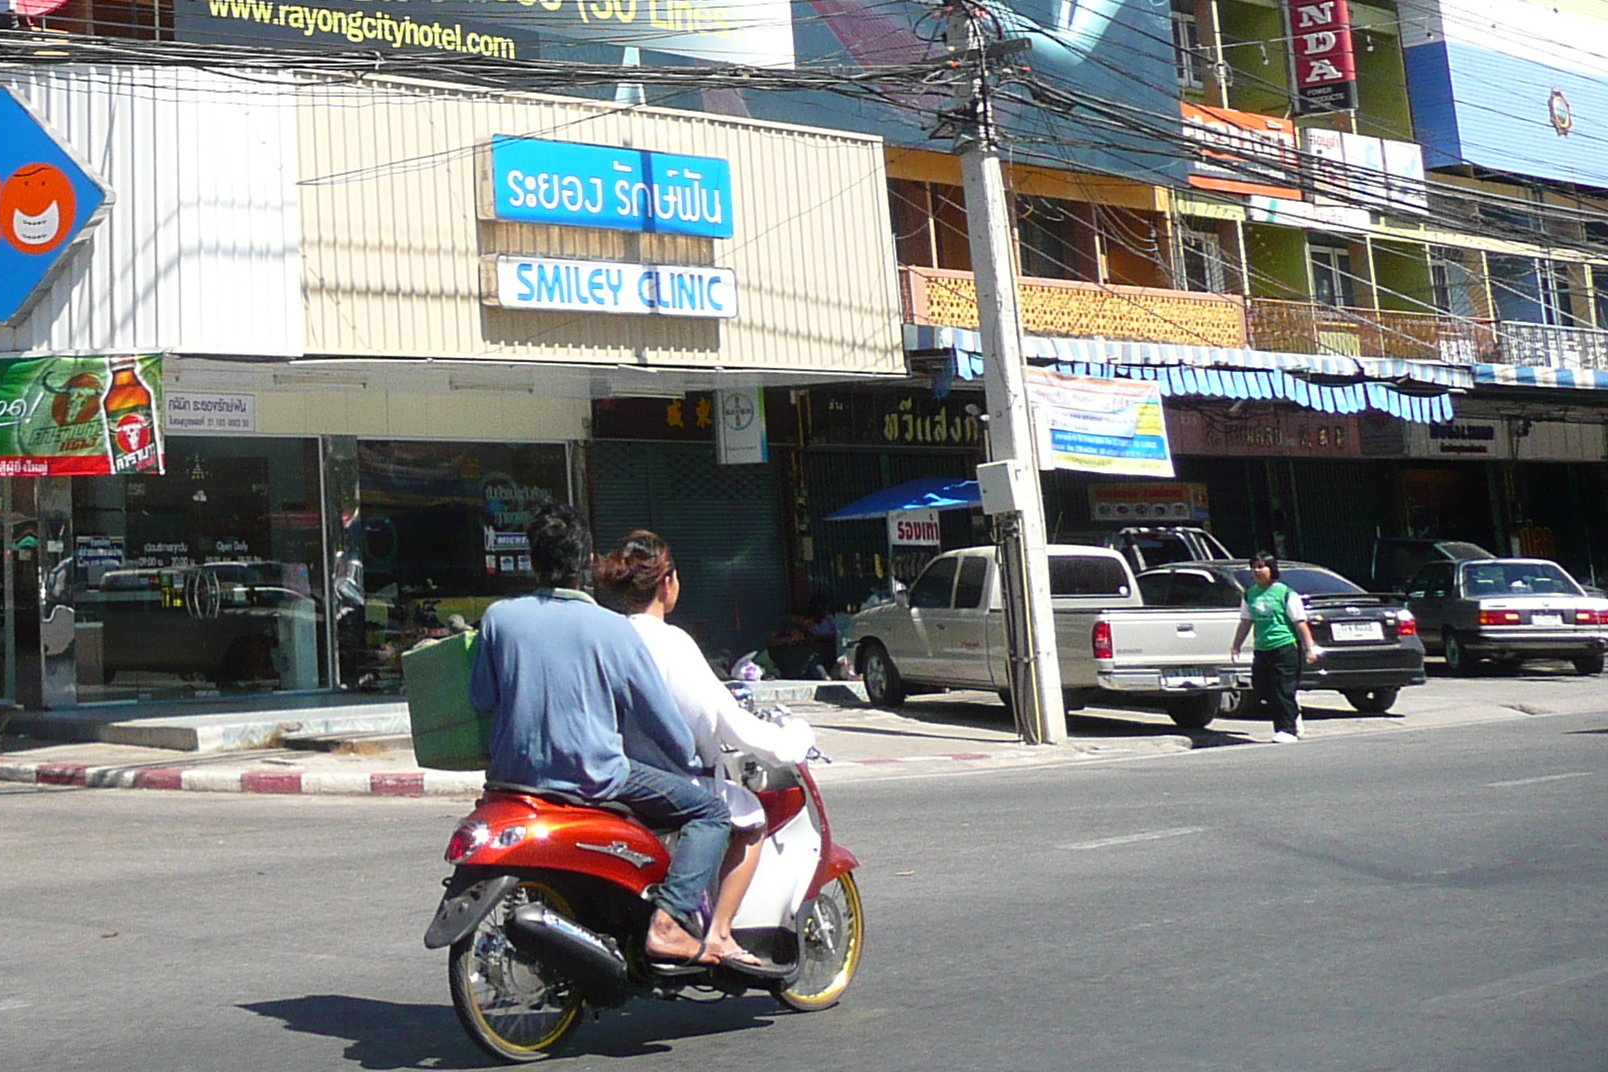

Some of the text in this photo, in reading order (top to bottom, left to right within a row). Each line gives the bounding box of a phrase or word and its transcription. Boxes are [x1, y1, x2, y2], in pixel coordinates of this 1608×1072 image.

[507, 160, 722, 224] ระยอง รักษ์ฟัน
[517, 263, 723, 311] SMILEY CLINIC
